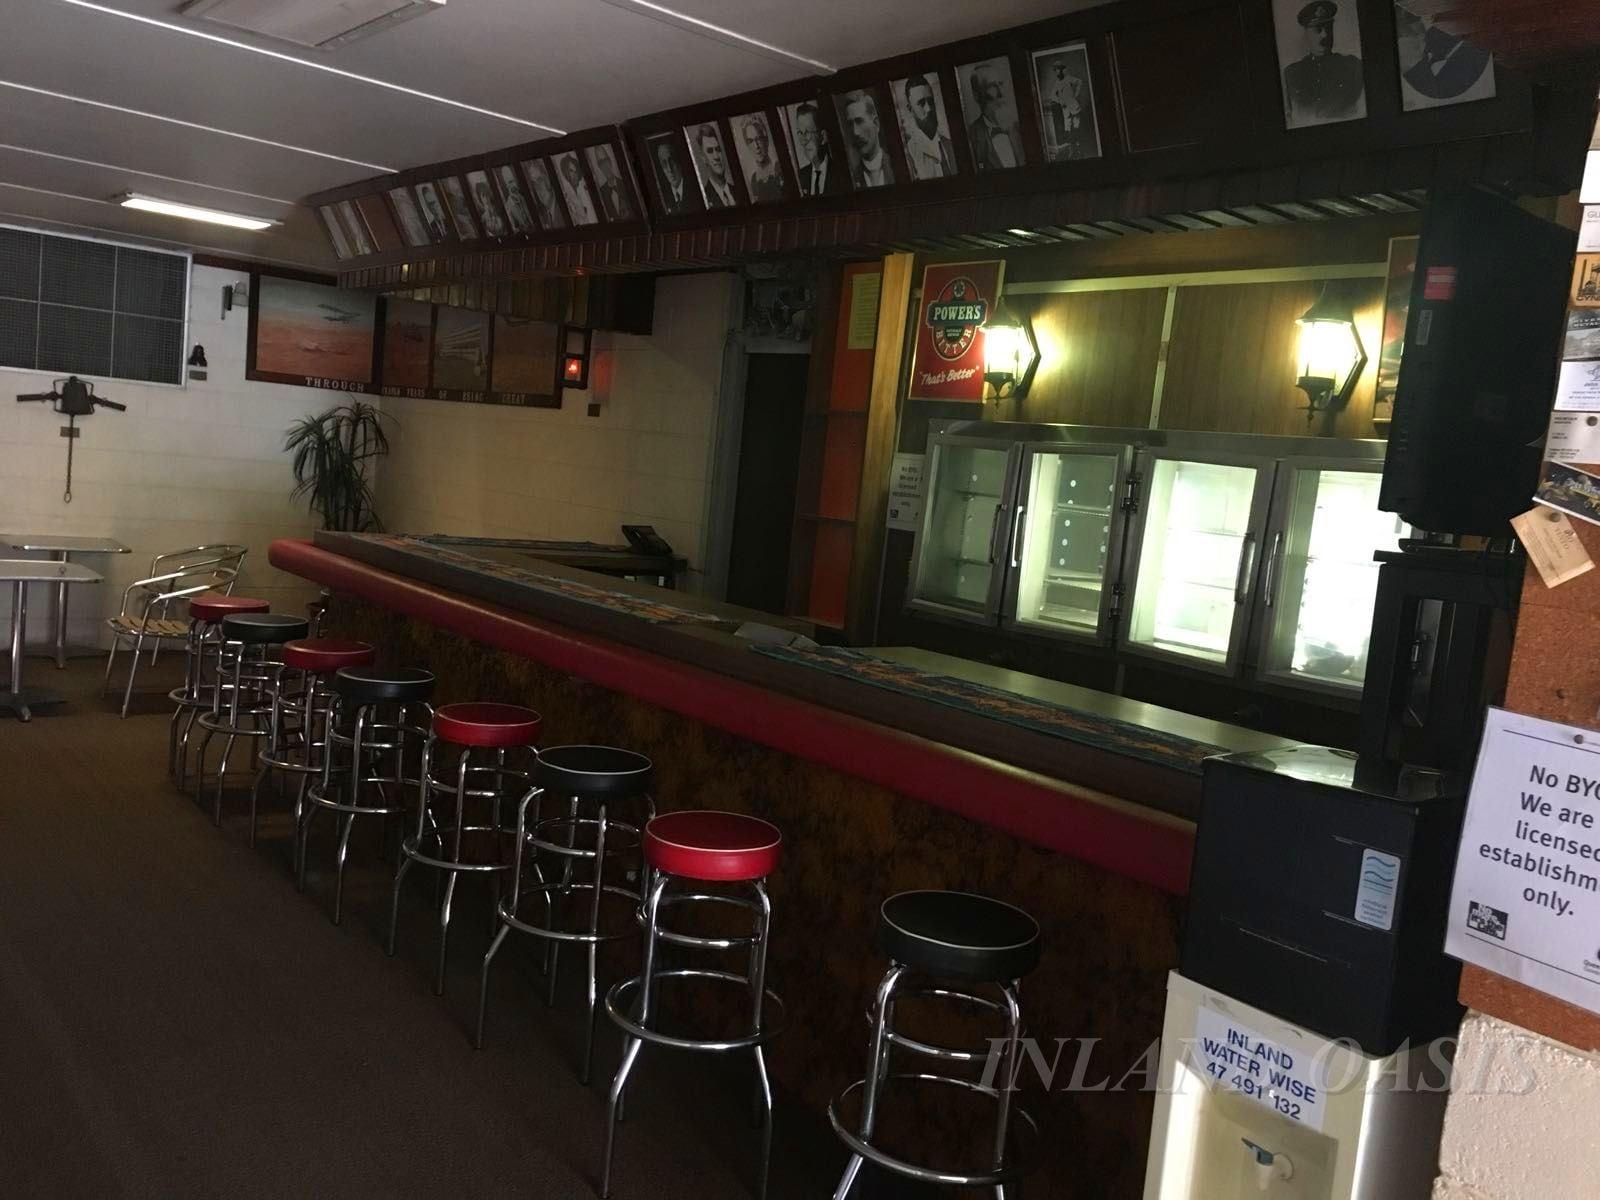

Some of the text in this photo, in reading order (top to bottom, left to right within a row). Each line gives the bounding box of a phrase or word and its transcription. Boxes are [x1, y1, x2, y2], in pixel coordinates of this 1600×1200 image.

[936, 328, 972, 355] BITTER
[304, 376, 365, 392] THROUGH
[1529, 765, 1558, 788] No
[1520, 791, 1594, 829] We are
[1479, 843, 1600, 892] establishm
[1523, 886, 1574, 917] only.
[1227, 1028, 1293, 1070] INLAND
[1203, 1037, 1317, 1104] WATER WISE
[1207, 1061, 1301, 1120] 47 491 132
